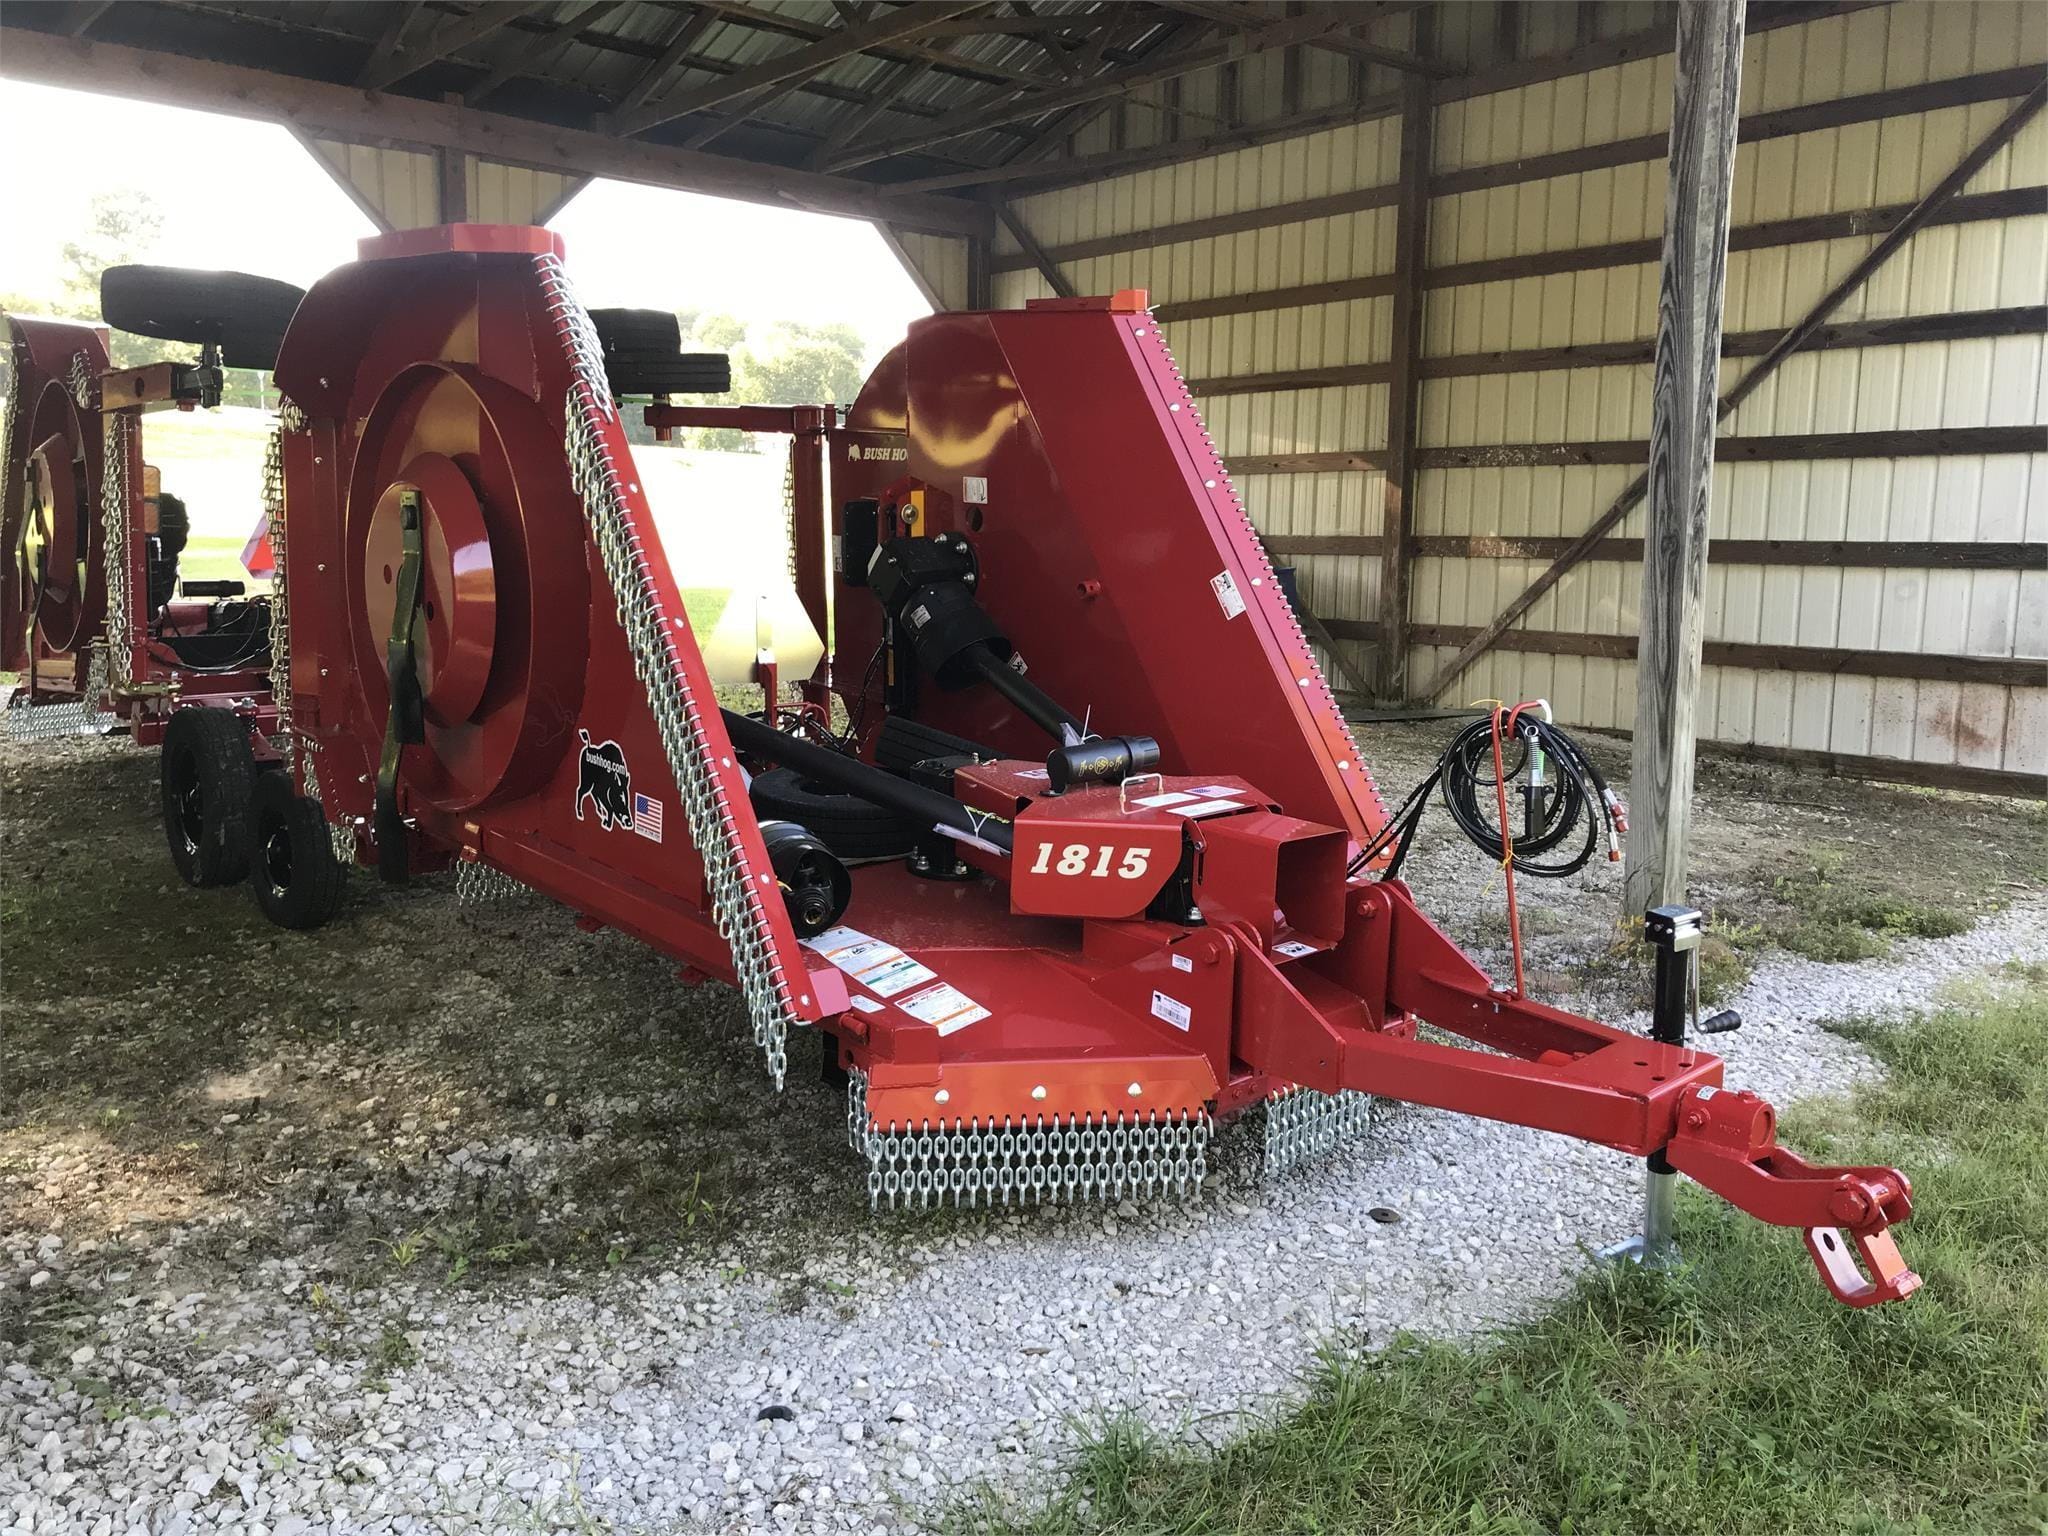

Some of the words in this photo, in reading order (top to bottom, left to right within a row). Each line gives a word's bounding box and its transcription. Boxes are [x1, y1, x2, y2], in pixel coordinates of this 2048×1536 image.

[863, 447, 891, 460] BUSH
[891, 448, 908, 461] HO
[586, 750, 626, 775] bushhog.com
[1030, 842, 1152, 880] 1815
